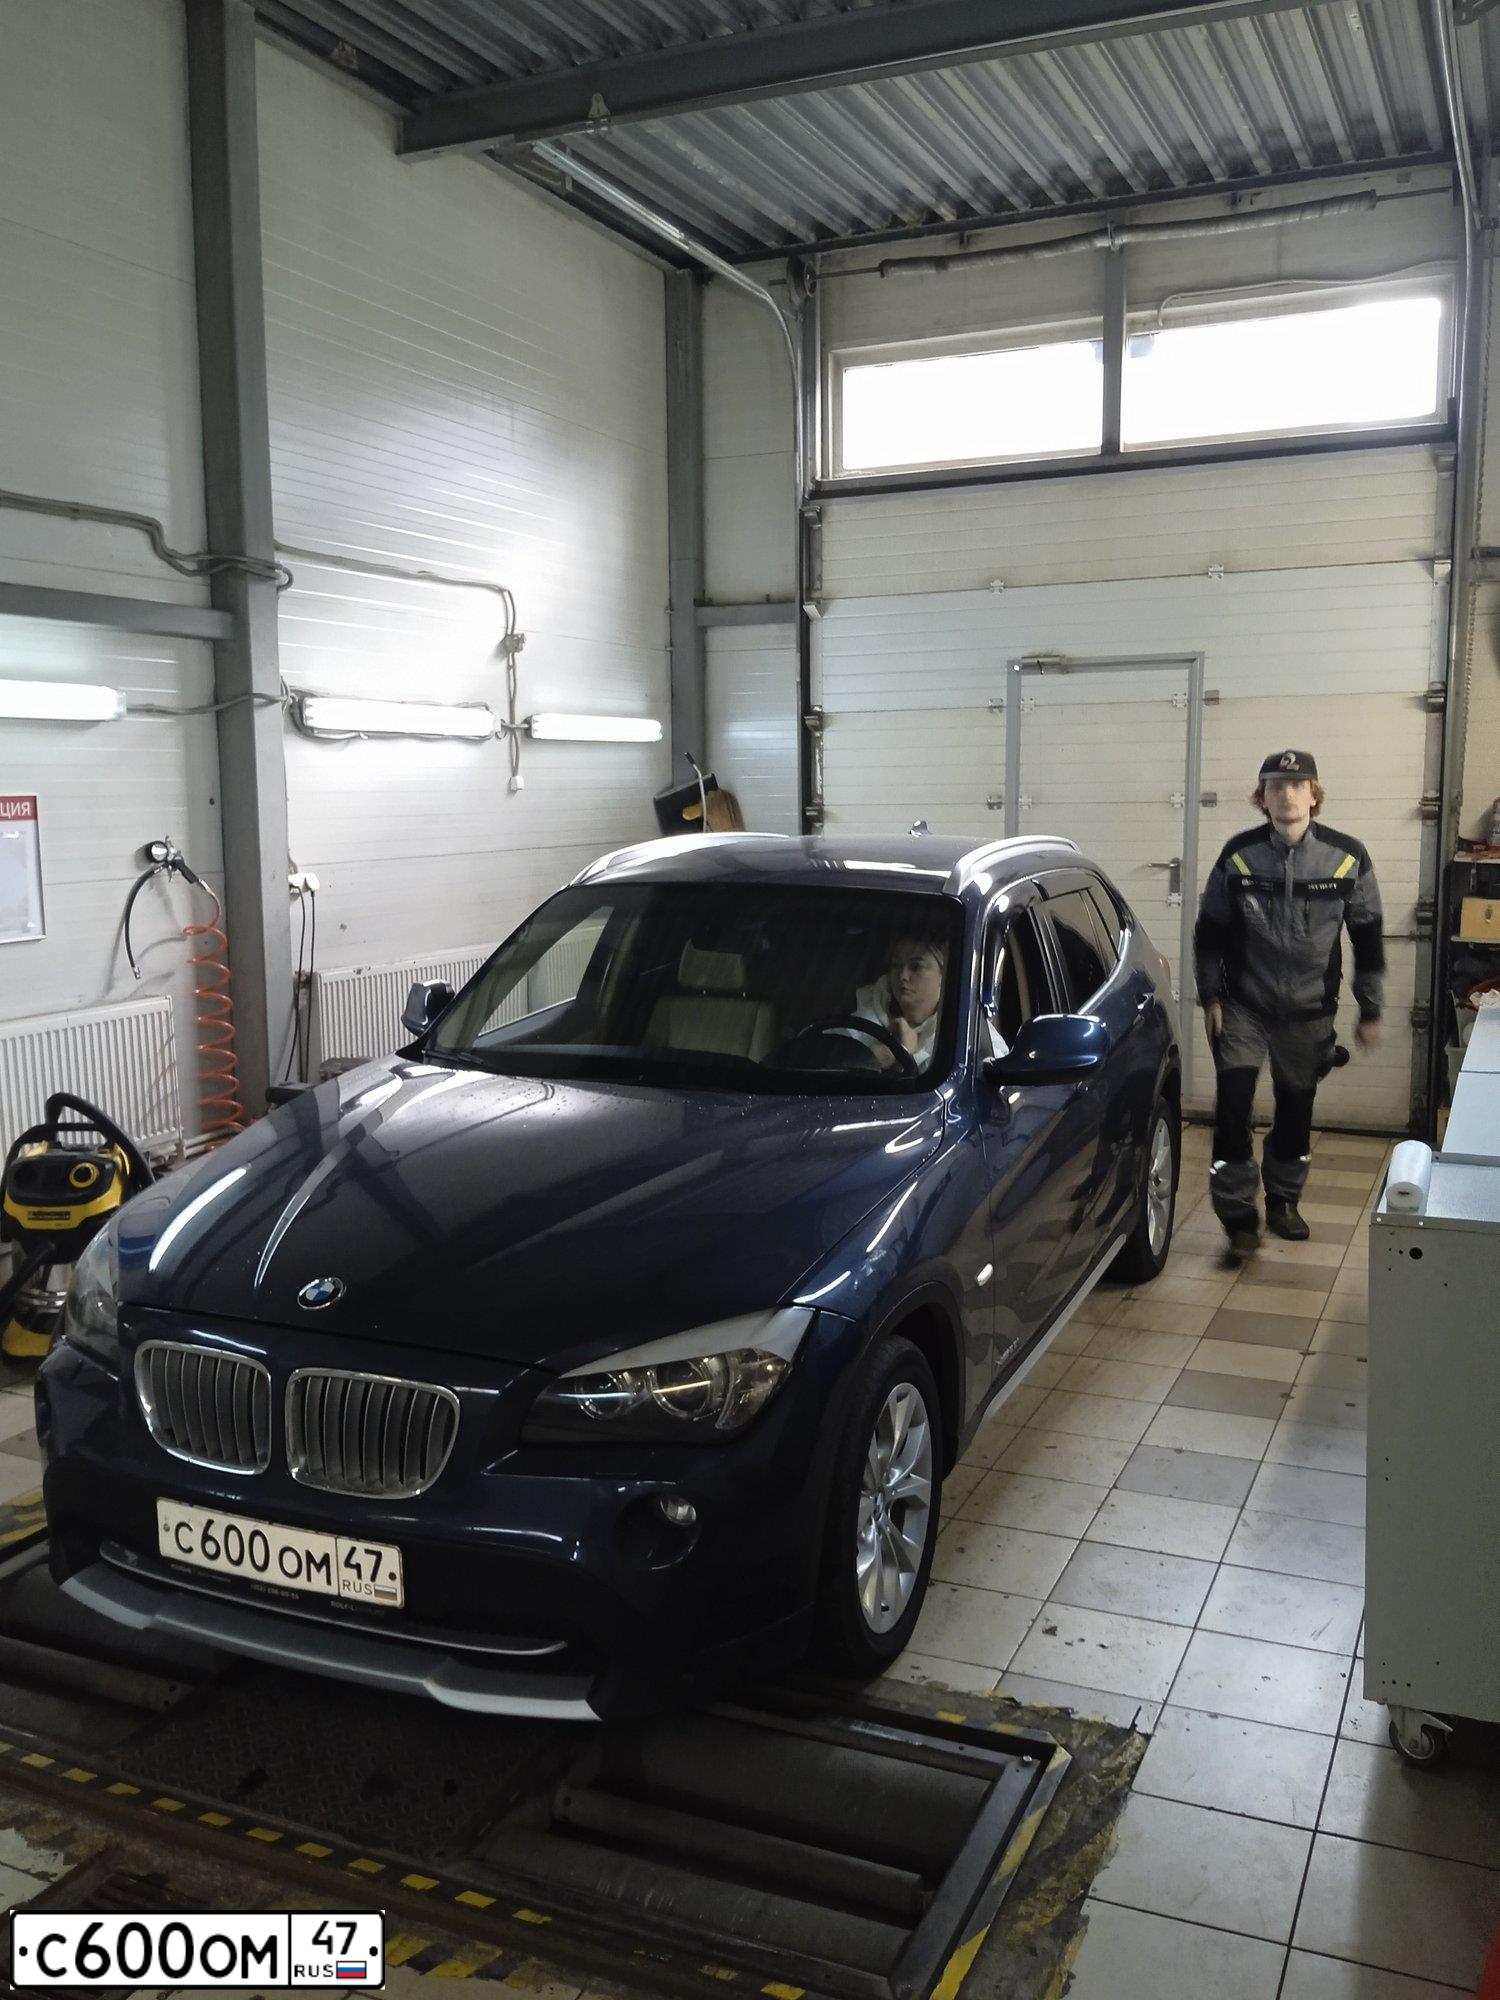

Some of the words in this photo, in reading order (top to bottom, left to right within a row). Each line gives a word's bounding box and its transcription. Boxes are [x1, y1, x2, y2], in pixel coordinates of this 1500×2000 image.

[0, 801, 32, 819] ЦИЯ
[343, 1546, 383, 1583] 47
[342, 1579, 373, 1596] RUS
